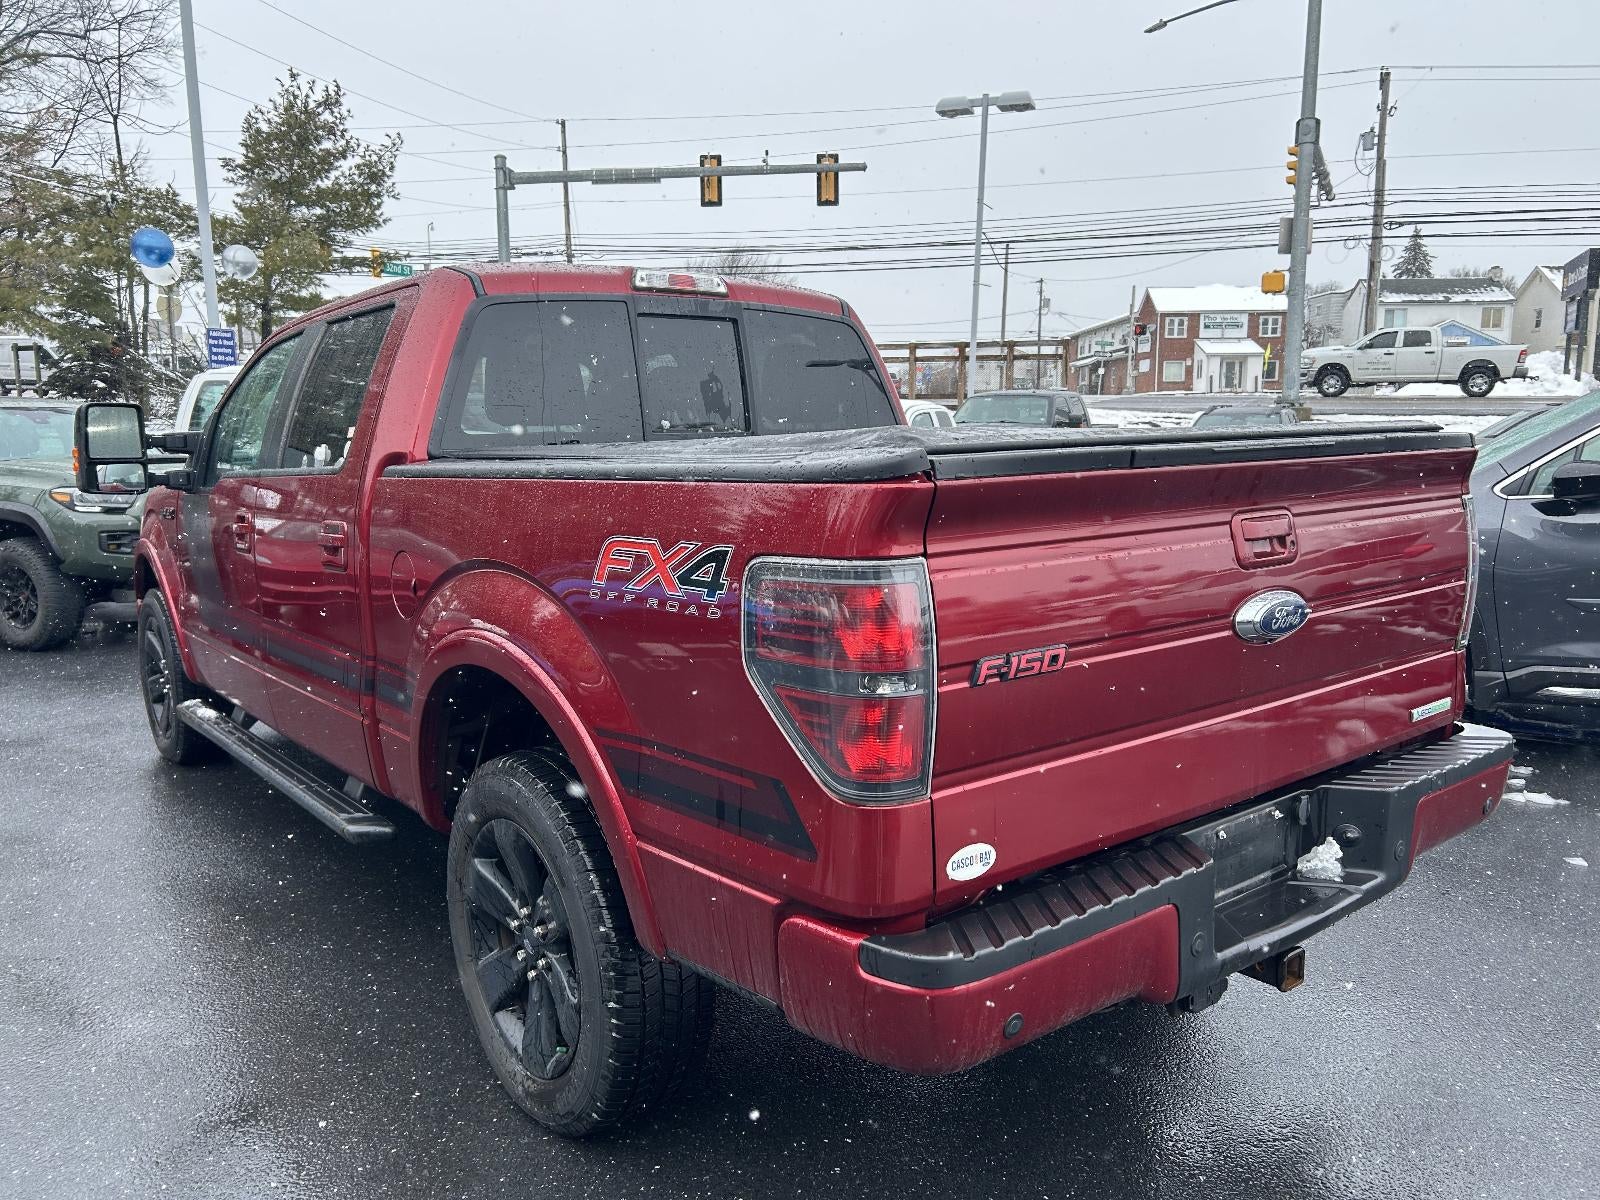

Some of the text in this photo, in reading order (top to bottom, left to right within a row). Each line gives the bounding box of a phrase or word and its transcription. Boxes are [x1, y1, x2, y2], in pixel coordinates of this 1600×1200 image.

[386, 263, 411, 275] 32nd St
[592, 534, 735, 604] FX4
[589, 588, 722, 619] OFF ROAD
[1271, 605, 1302, 631] Ford
[971, 643, 1068, 686] F-150
[951, 850, 992, 872] CASCO BAY
